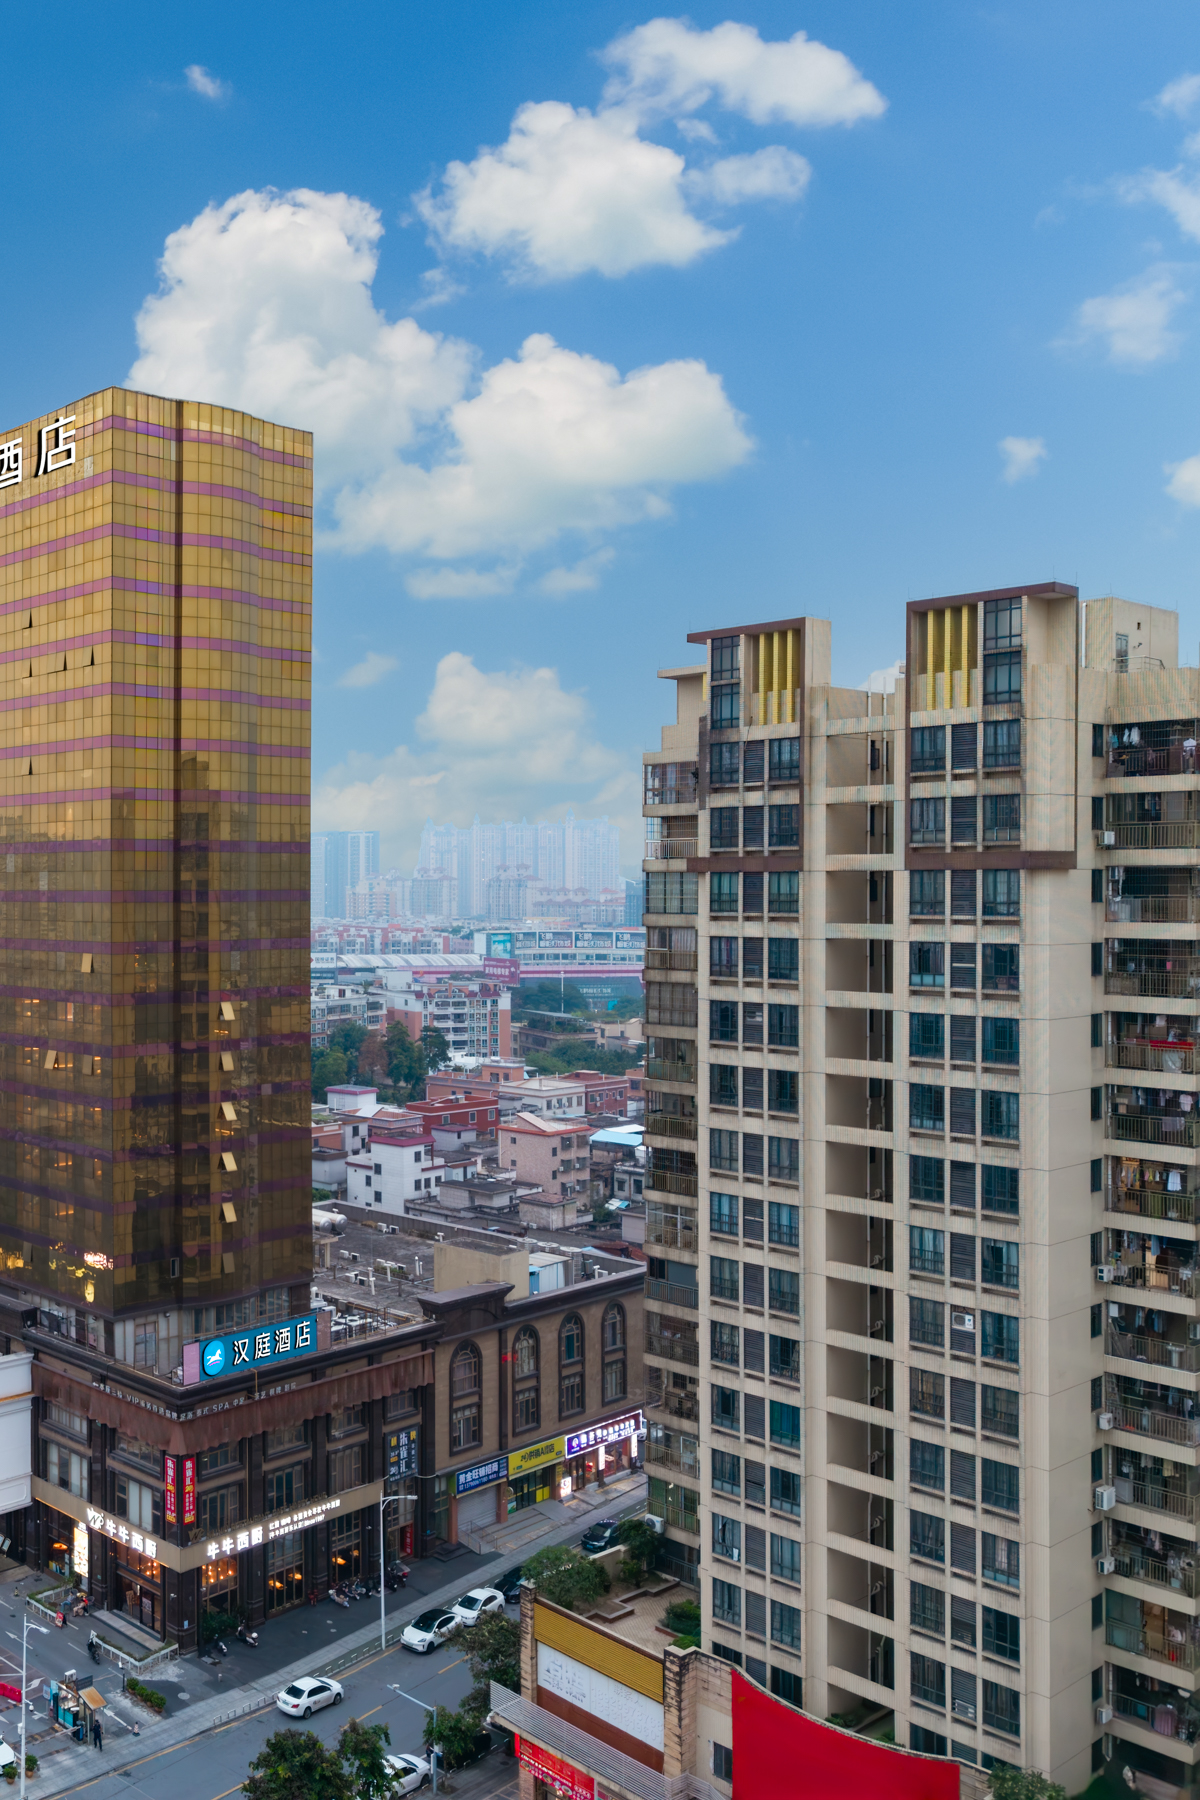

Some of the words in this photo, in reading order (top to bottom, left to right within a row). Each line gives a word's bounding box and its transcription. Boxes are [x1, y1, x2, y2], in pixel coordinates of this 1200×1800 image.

[234, 1320, 311, 1365] 汉庭酒店
[212, 1401, 230, 1413] SPA
